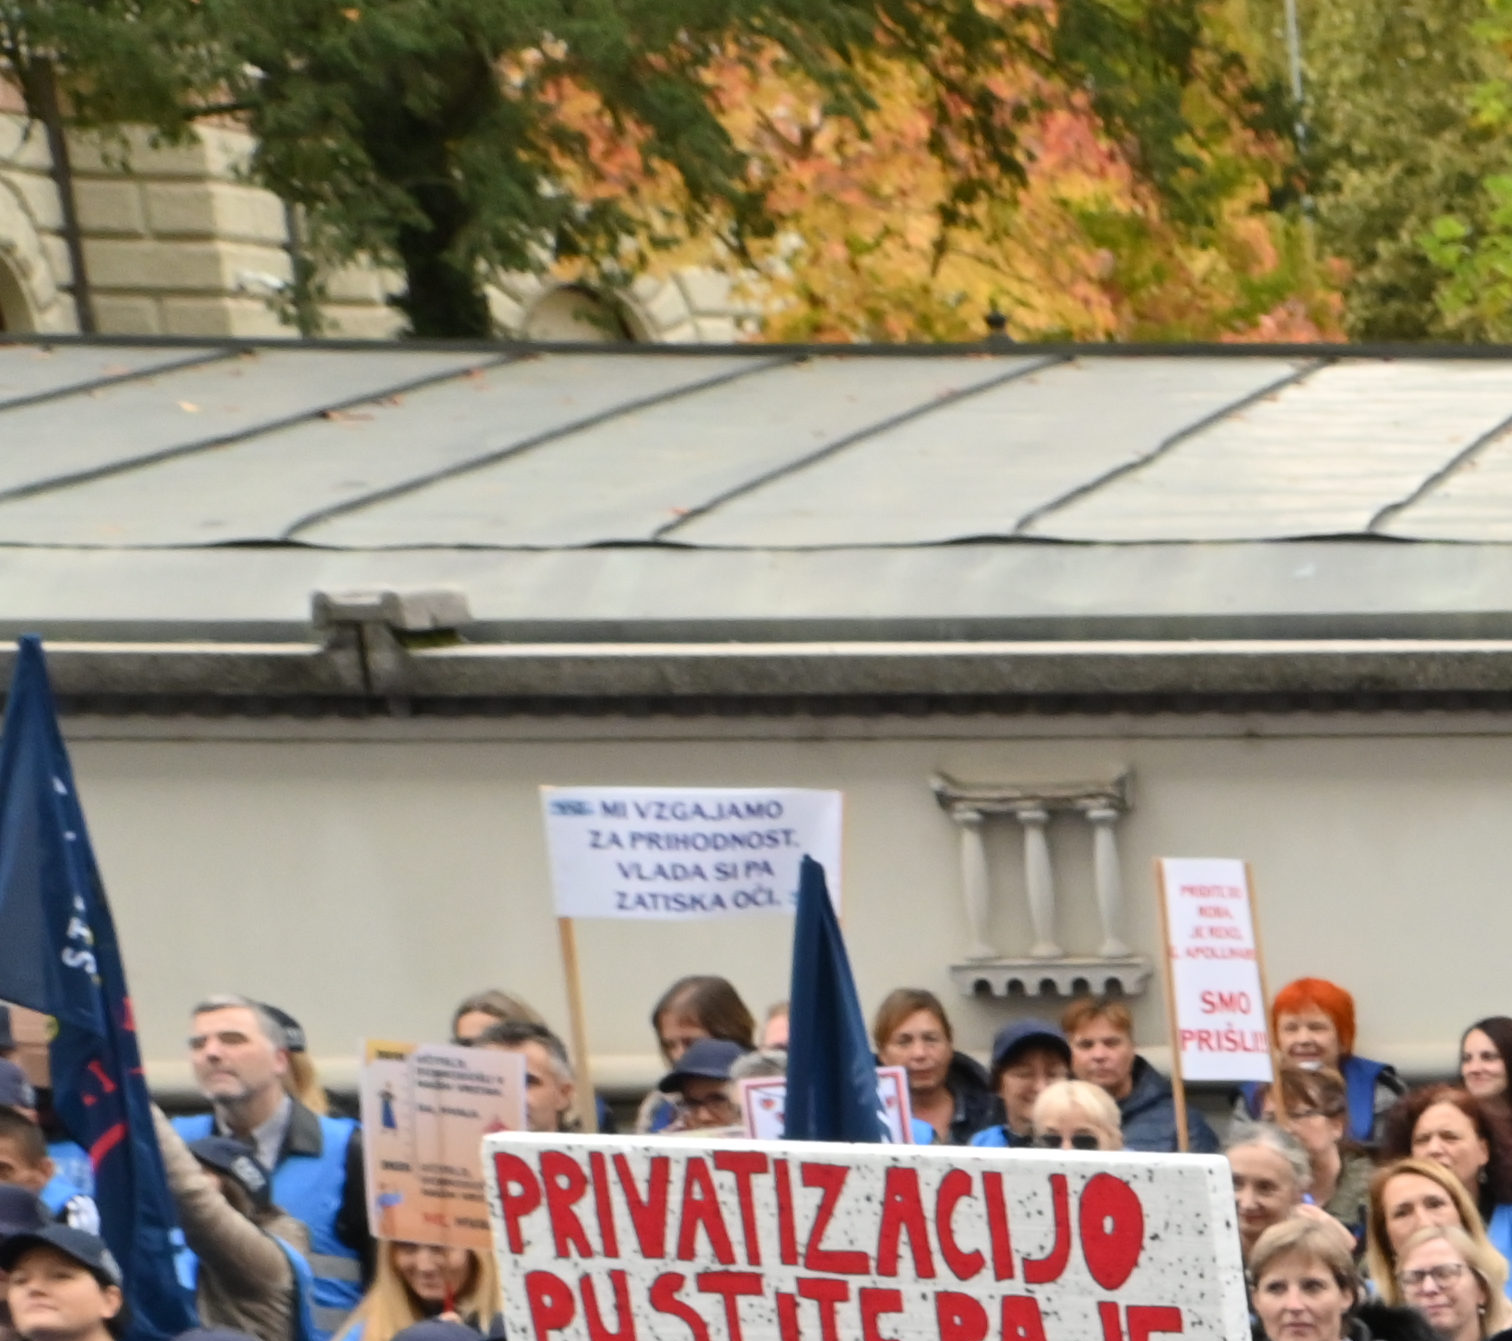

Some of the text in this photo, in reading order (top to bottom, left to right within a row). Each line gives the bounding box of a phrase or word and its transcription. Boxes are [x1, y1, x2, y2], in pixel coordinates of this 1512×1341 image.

[601, 801, 628, 819] MI
[634, 800, 783, 820] VZGAJAMO
[589, 829, 623, 848] ZA
[617, 861, 774, 881] VLADA SI PA
[616, 890, 727, 911] ZATISKA
[1201, 990, 1252, 1015] SMO
[493, 1150, 1145, 1290] PRIVATIZACIJO
